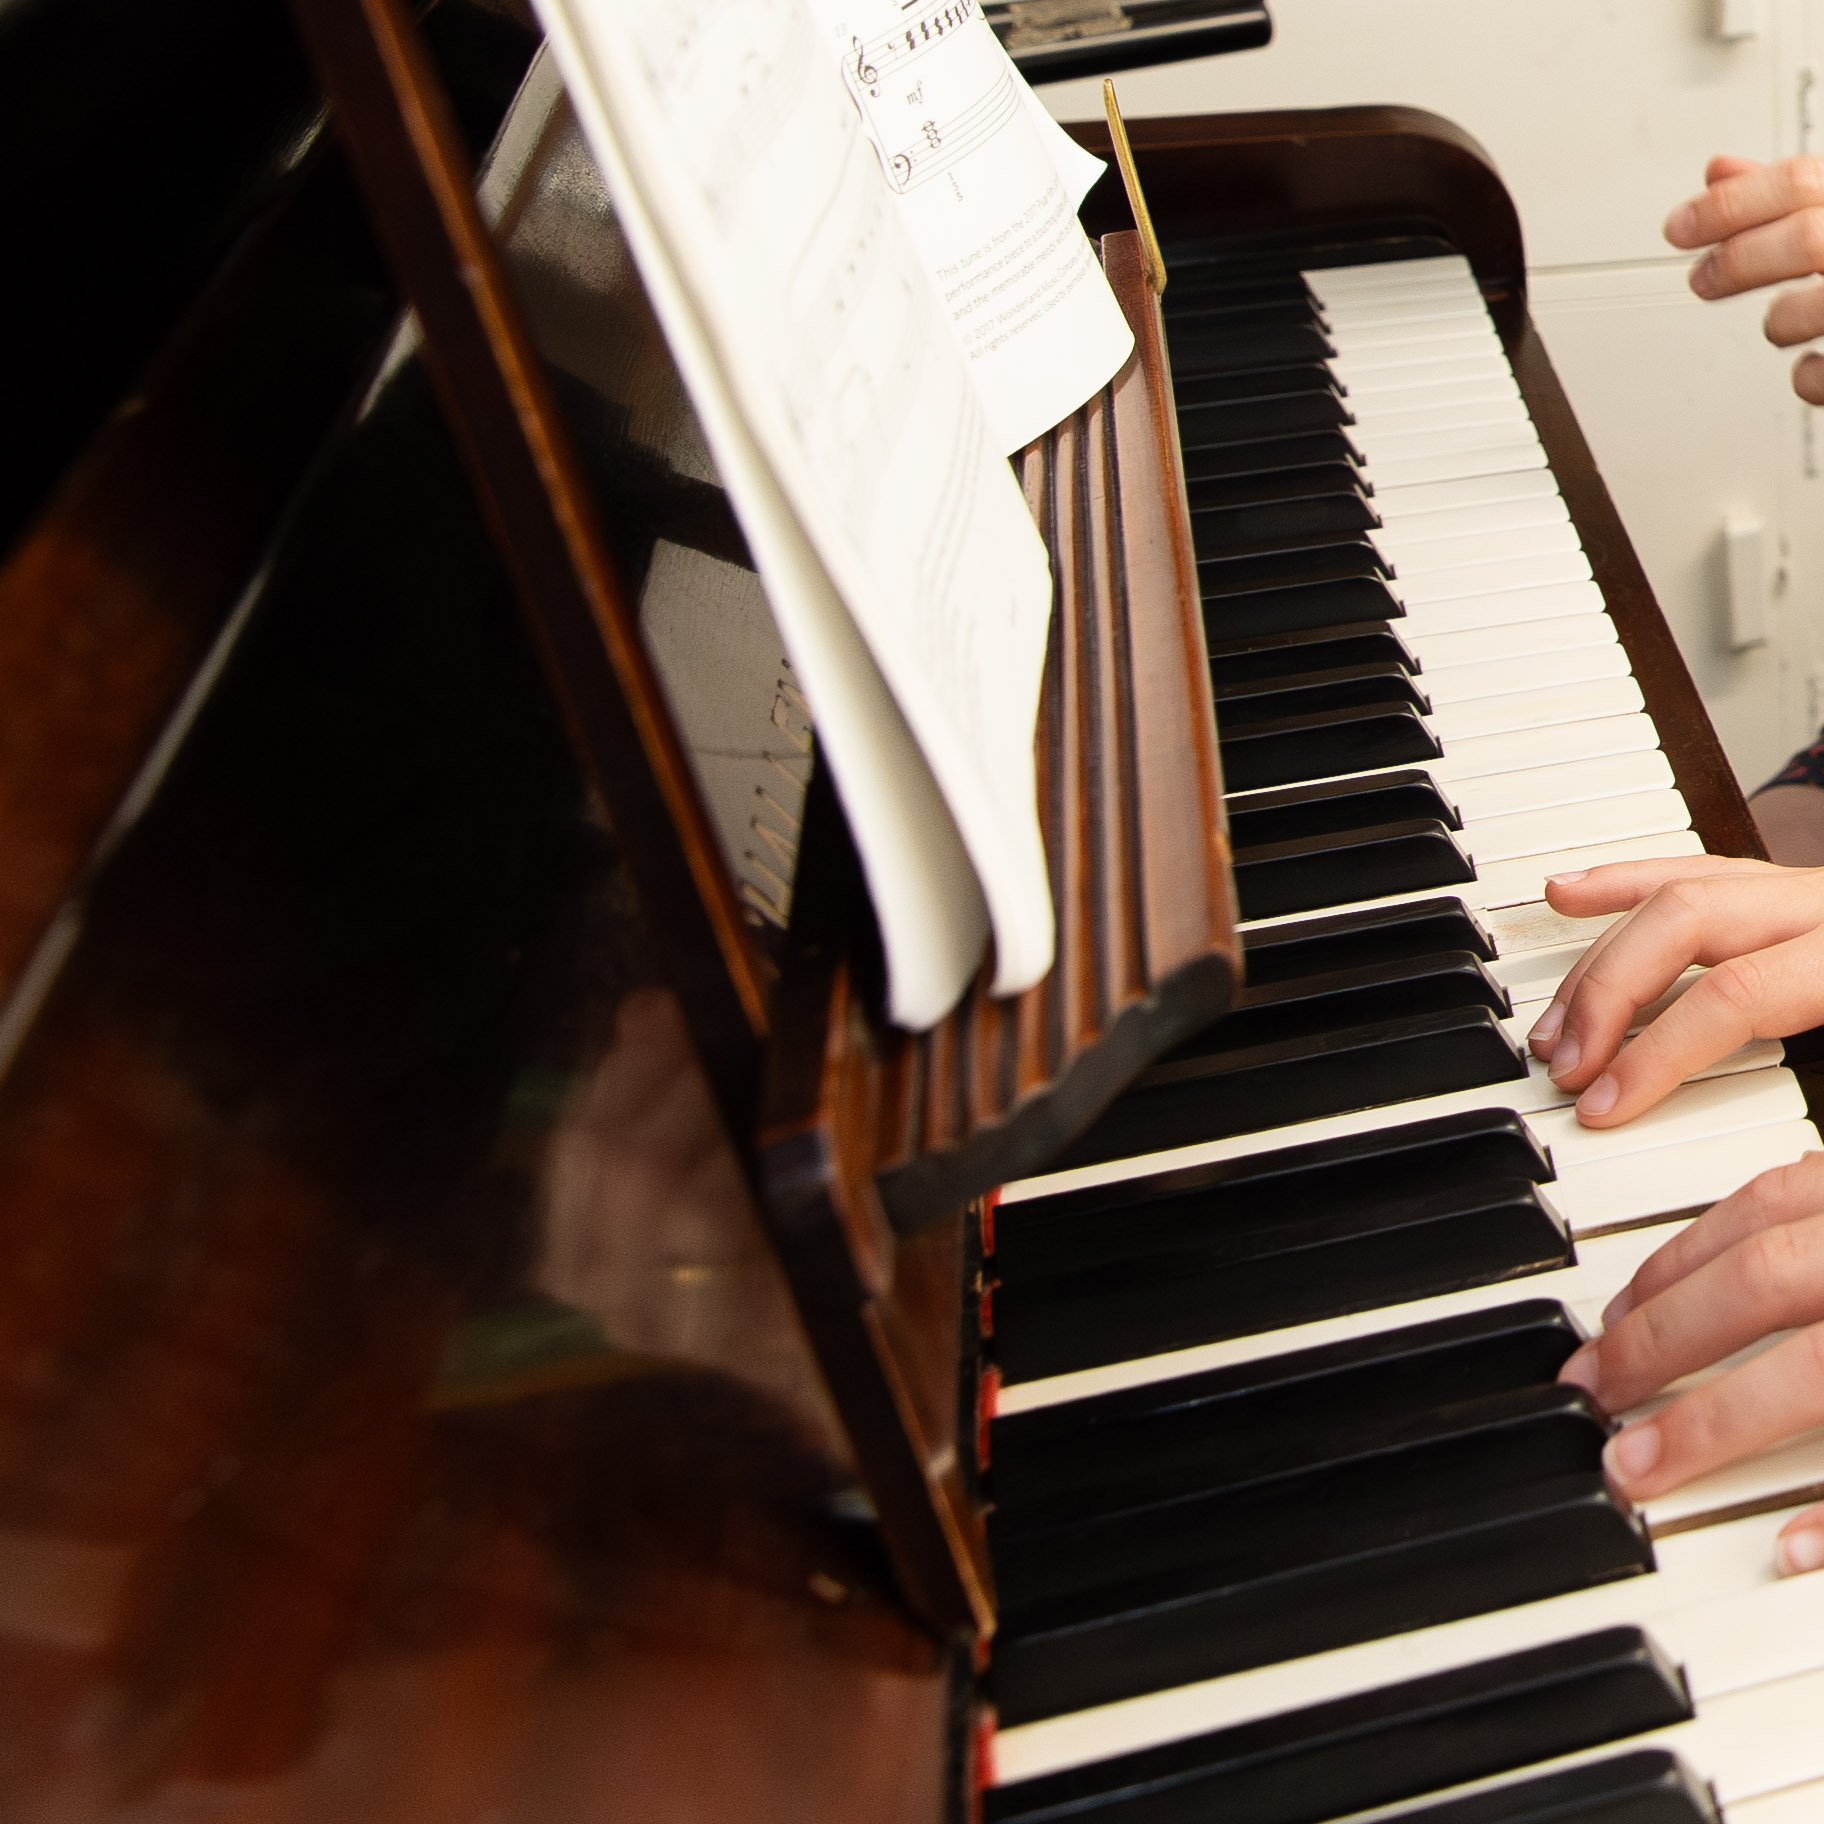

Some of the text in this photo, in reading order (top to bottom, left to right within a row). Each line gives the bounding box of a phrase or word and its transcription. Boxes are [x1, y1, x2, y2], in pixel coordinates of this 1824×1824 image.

[906, 80, 924, 105] mf
[936, 262, 960, 281] This
[961, 250, 982, 268] tune
[992, 229, 1012, 250] from
[945, 257, 1005, 303] performance
[952, 304, 973, 322] and
[973, 291, 991, 309] the
[991, 261, 1036, 297] memorable
[974, 318, 996, 341] 2017
[998, 288, 1043, 325] Wonderland
[970, 347, 984, 361] All
[984, 332, 1010, 353] rights
